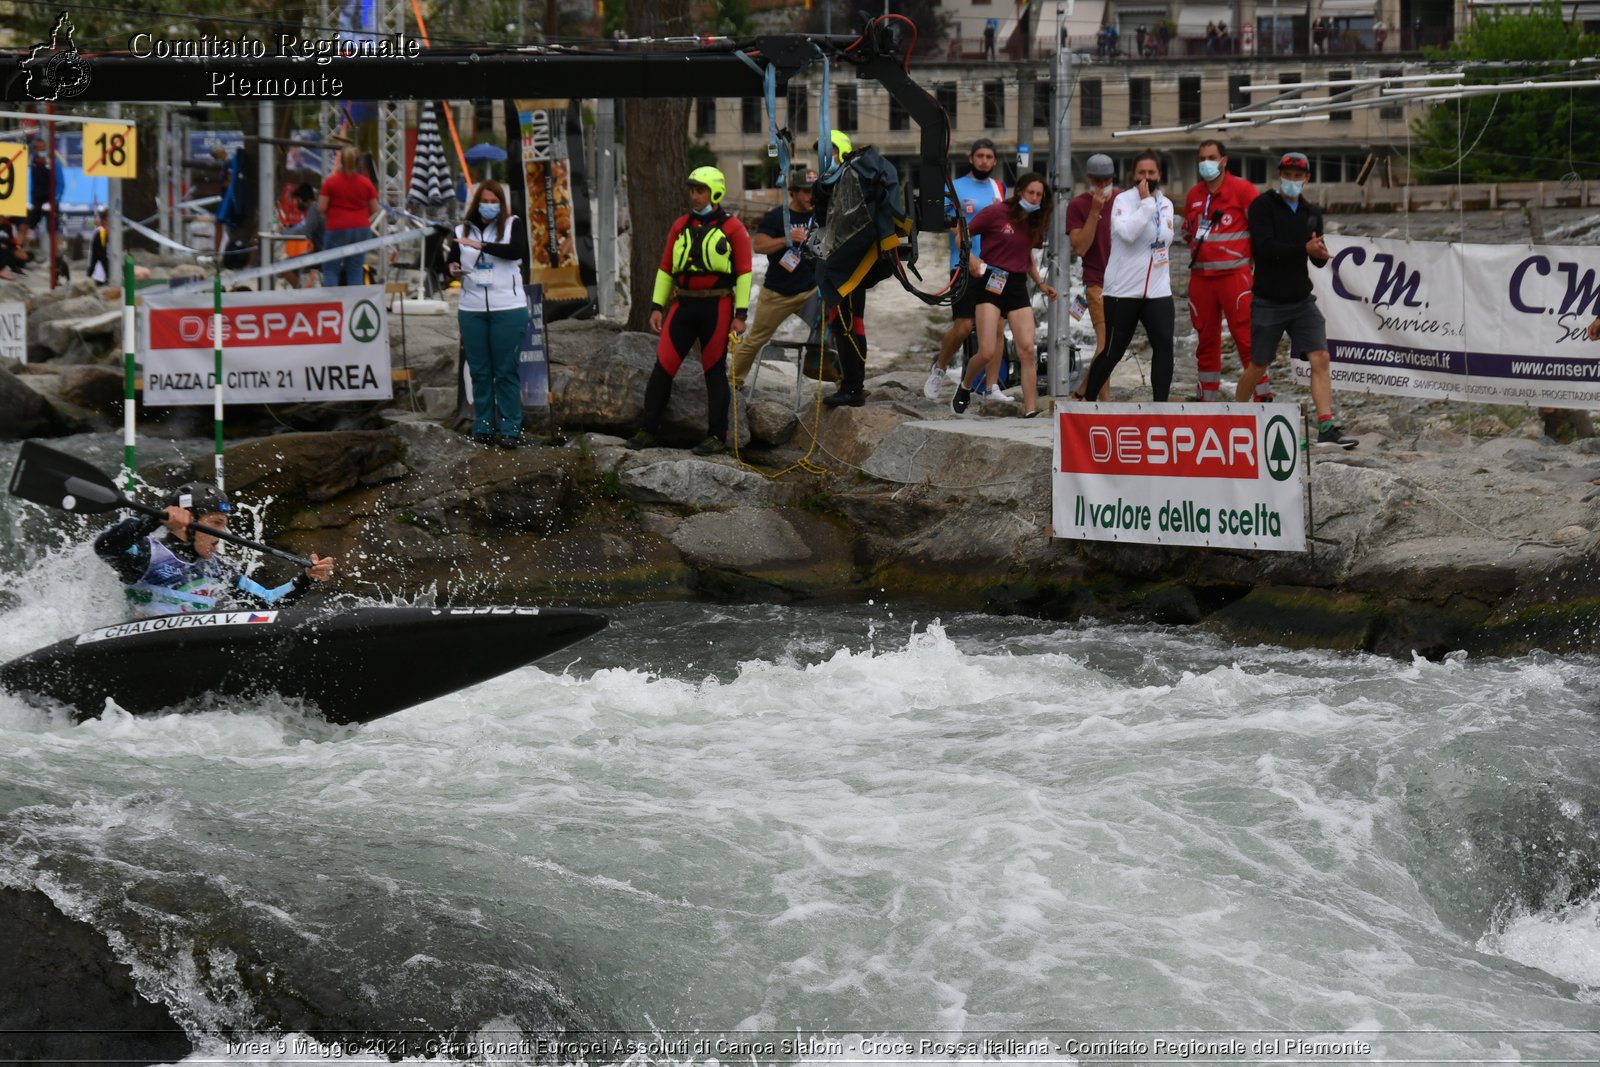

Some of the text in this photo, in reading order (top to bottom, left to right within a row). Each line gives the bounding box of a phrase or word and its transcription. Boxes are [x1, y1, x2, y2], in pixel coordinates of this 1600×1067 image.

[95, 132, 126, 166] 18
[532, 110, 550, 161] KIND
[179, 310, 341, 342] DESPAR
[1373, 302, 1440, 333] Service
[1336, 345, 1450, 369] www.cmservicesrl.it
[150, 373, 203, 390] PIAZZA
[207, 372, 217, 389] D
[277, 370, 294, 388] 21
[305, 364, 378, 391] IVREA
[1331, 369, 1364, 383] SERVICE
[1366, 373, 1409, 387] PROVIDER
[1089, 426, 1255, 466] DESPAR
[1075, 495, 1281, 537] Il valore della scelta
[105, 614, 237, 638] CHALOUPKA V.
